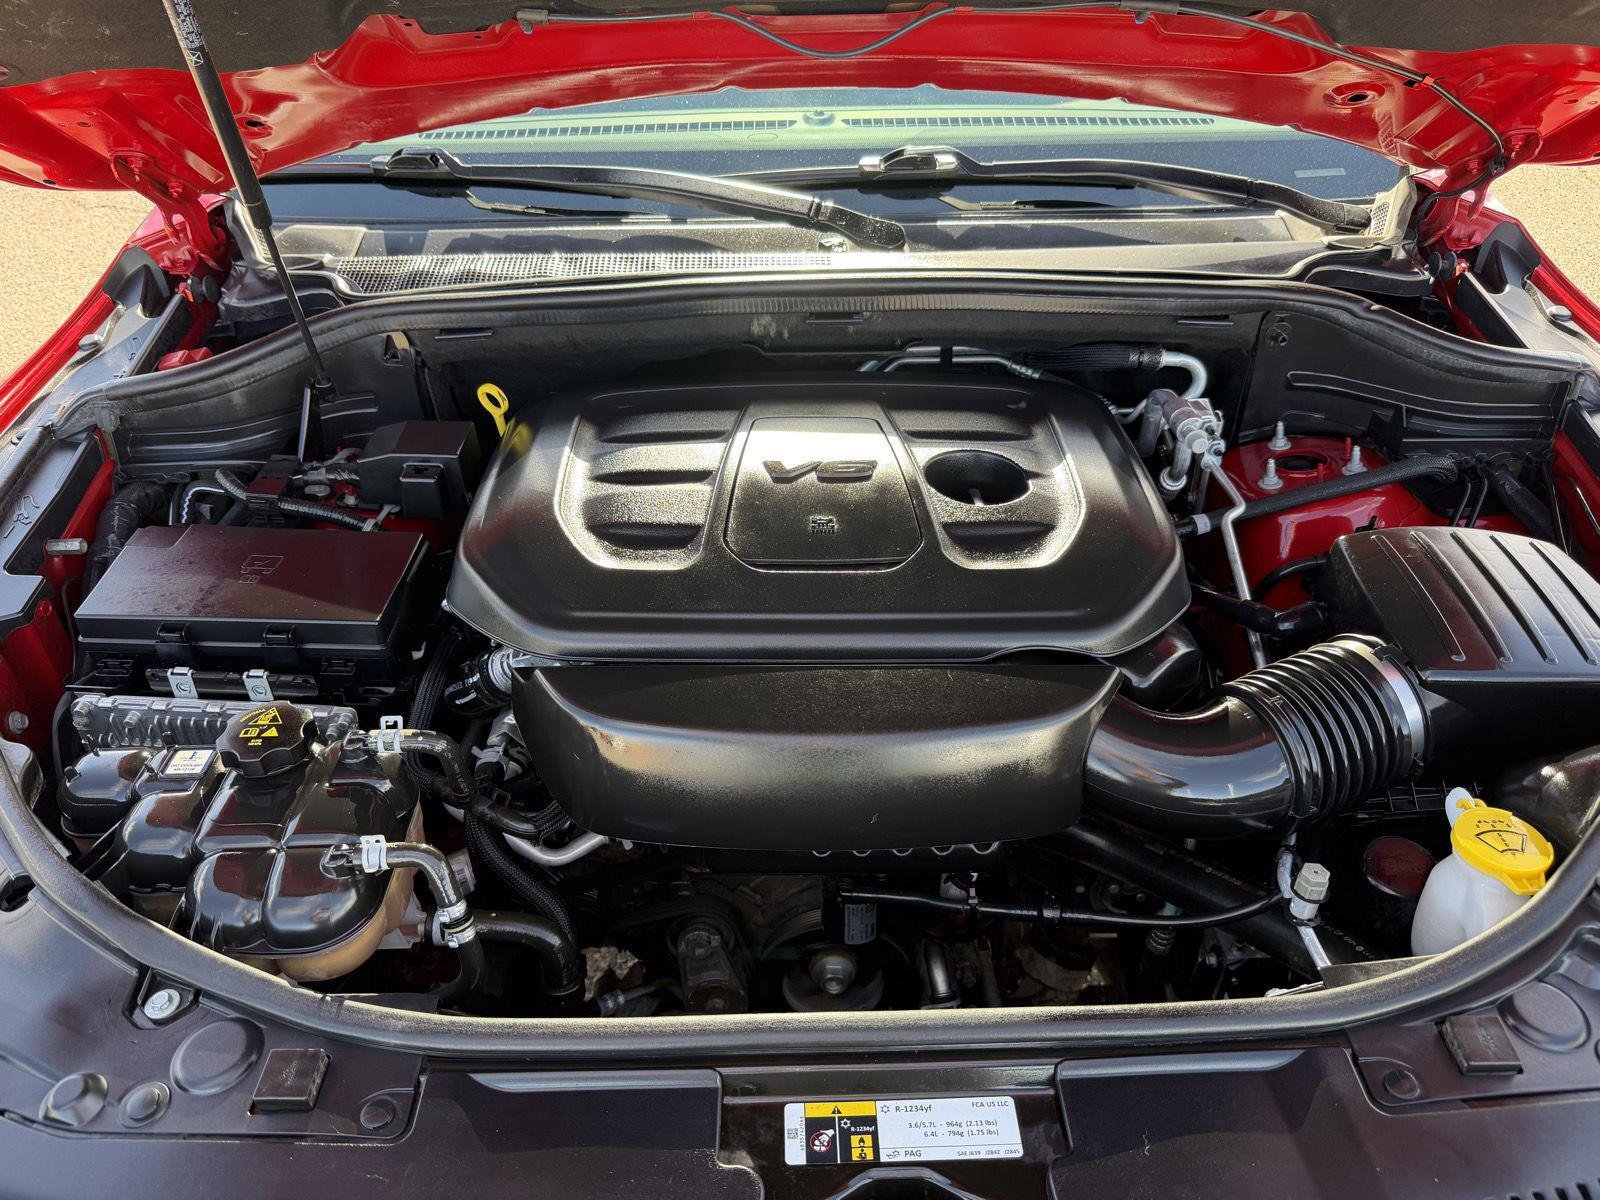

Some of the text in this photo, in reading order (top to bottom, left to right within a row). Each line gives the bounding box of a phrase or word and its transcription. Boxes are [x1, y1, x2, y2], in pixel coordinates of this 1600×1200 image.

[762, 460, 878, 484] V6
[895, 1104, 932, 1113] R-1234yf
[908, 1121, 937, 1129] 3.6/5.7L
[945, 1120, 962, 1128] 964g
[965, 1120, 983, 1128] (2.13
[984, 1119, 998, 1127] lbs)
[924, 1130, 939, 1138] 6.4L
[967, 1129, 985, 1137] (1.75
[986, 1128, 999, 1136] lbs)
